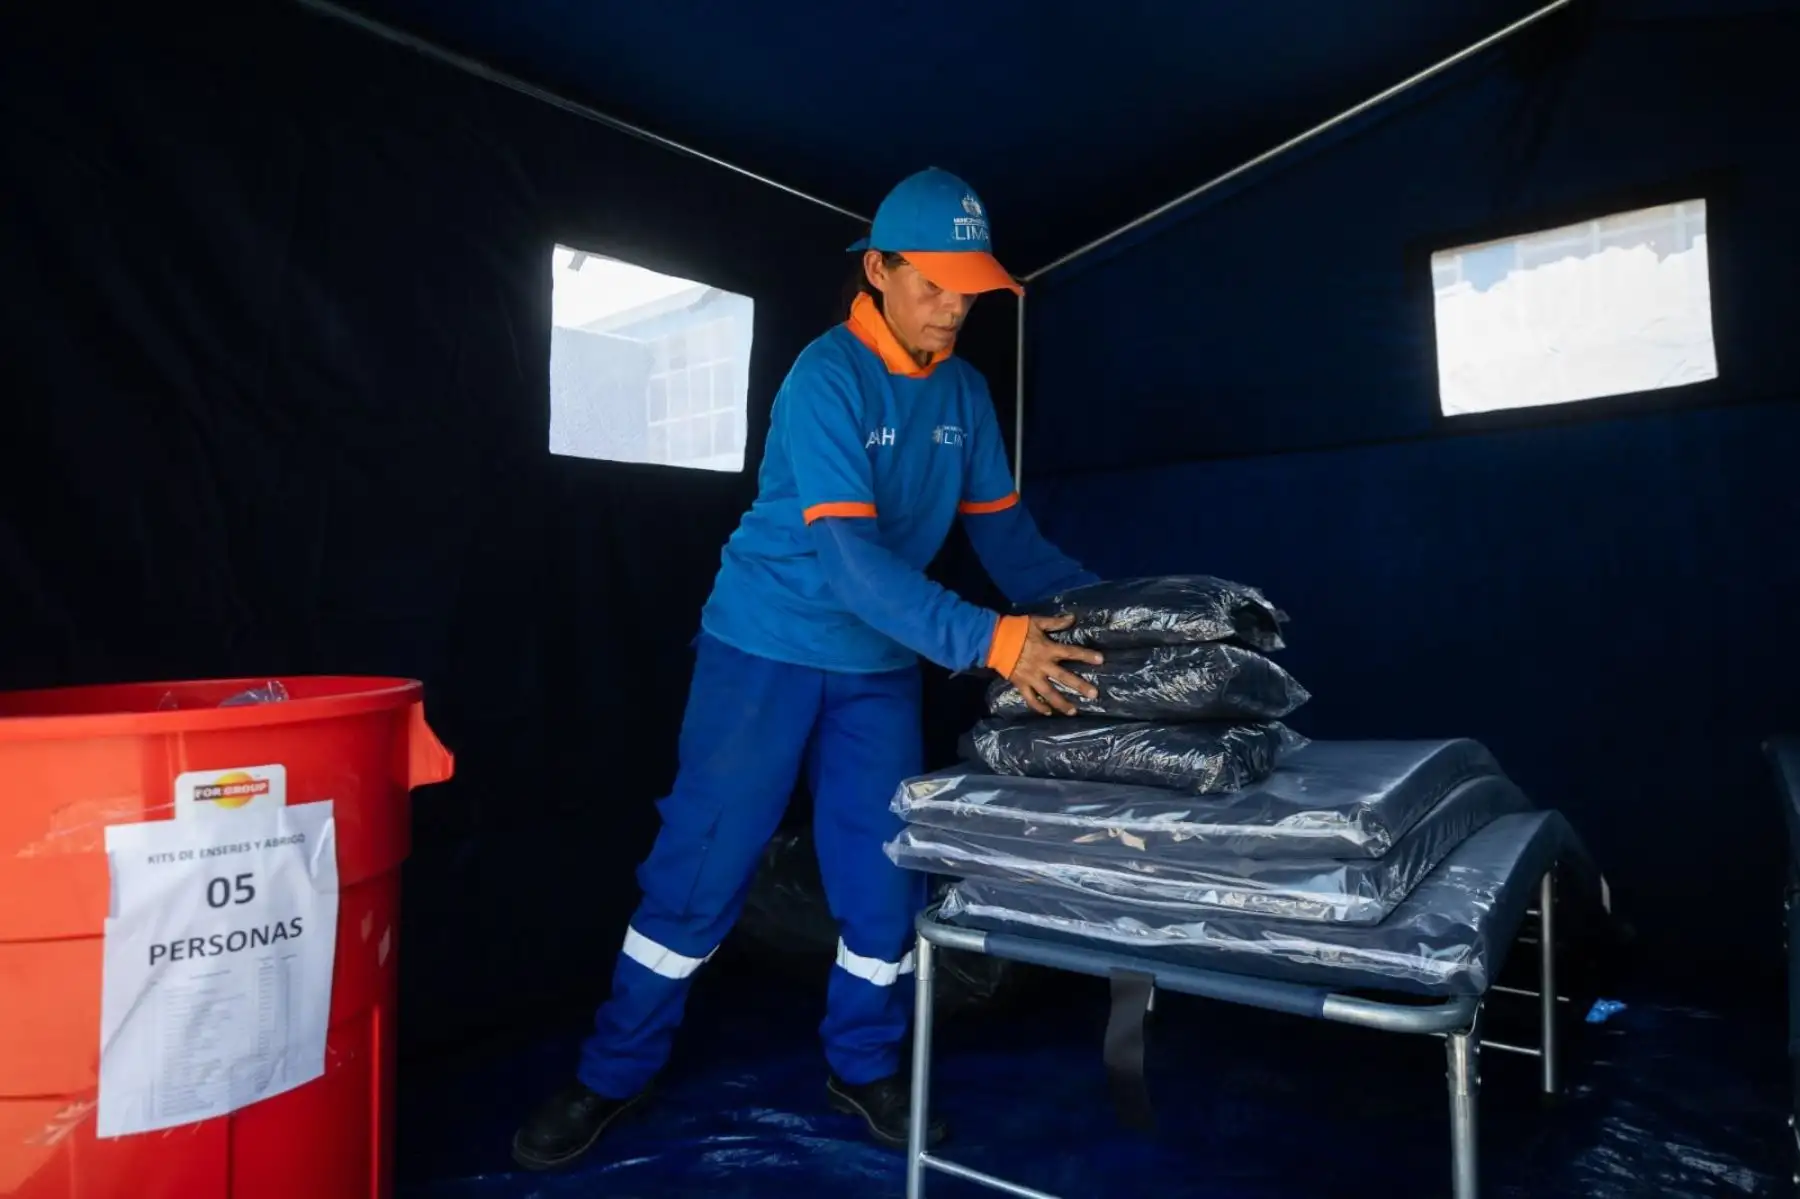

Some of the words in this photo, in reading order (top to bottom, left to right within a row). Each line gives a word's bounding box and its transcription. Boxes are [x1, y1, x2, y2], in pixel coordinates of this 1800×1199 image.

[195, 786, 222, 798] FOR
[224, 781, 267, 796] GROUP
[148, 853, 175, 864] KITS
[178, 850, 194, 861] DE
[200, 841, 250, 858] ENSERES
[254, 839, 261, 850] Y
[264, 833, 305, 848] ABRIGO
[206, 872, 256, 909] 05
[149, 916, 303, 966] PERSONAS
